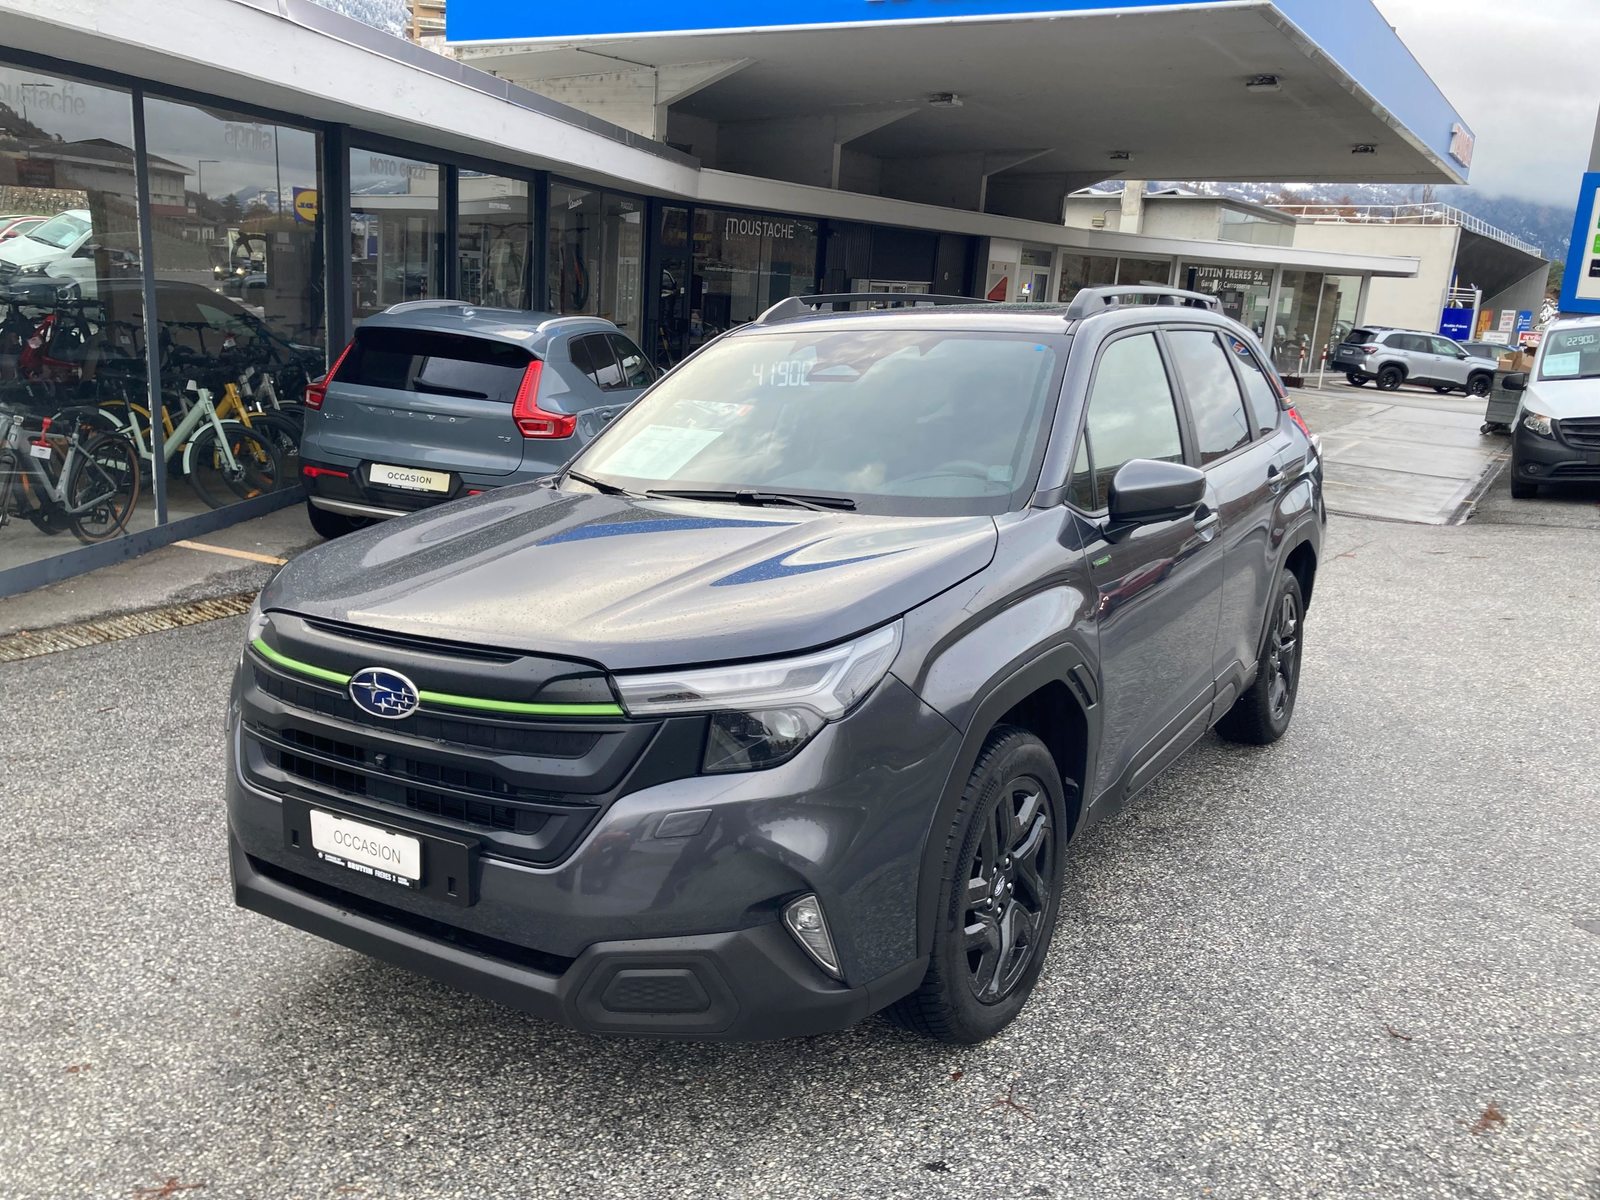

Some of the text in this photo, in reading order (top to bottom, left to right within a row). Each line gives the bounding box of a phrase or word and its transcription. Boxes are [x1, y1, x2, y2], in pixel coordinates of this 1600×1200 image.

[370, 156, 397, 176] MOTO
[726, 217, 795, 240] MOUSTACHE
[1225, 268, 1252, 280] FRERES
[1253, 270, 1263, 281] SA
[387, 471, 432, 485] OCCASION
[333, 829, 401, 864] OCCASION
